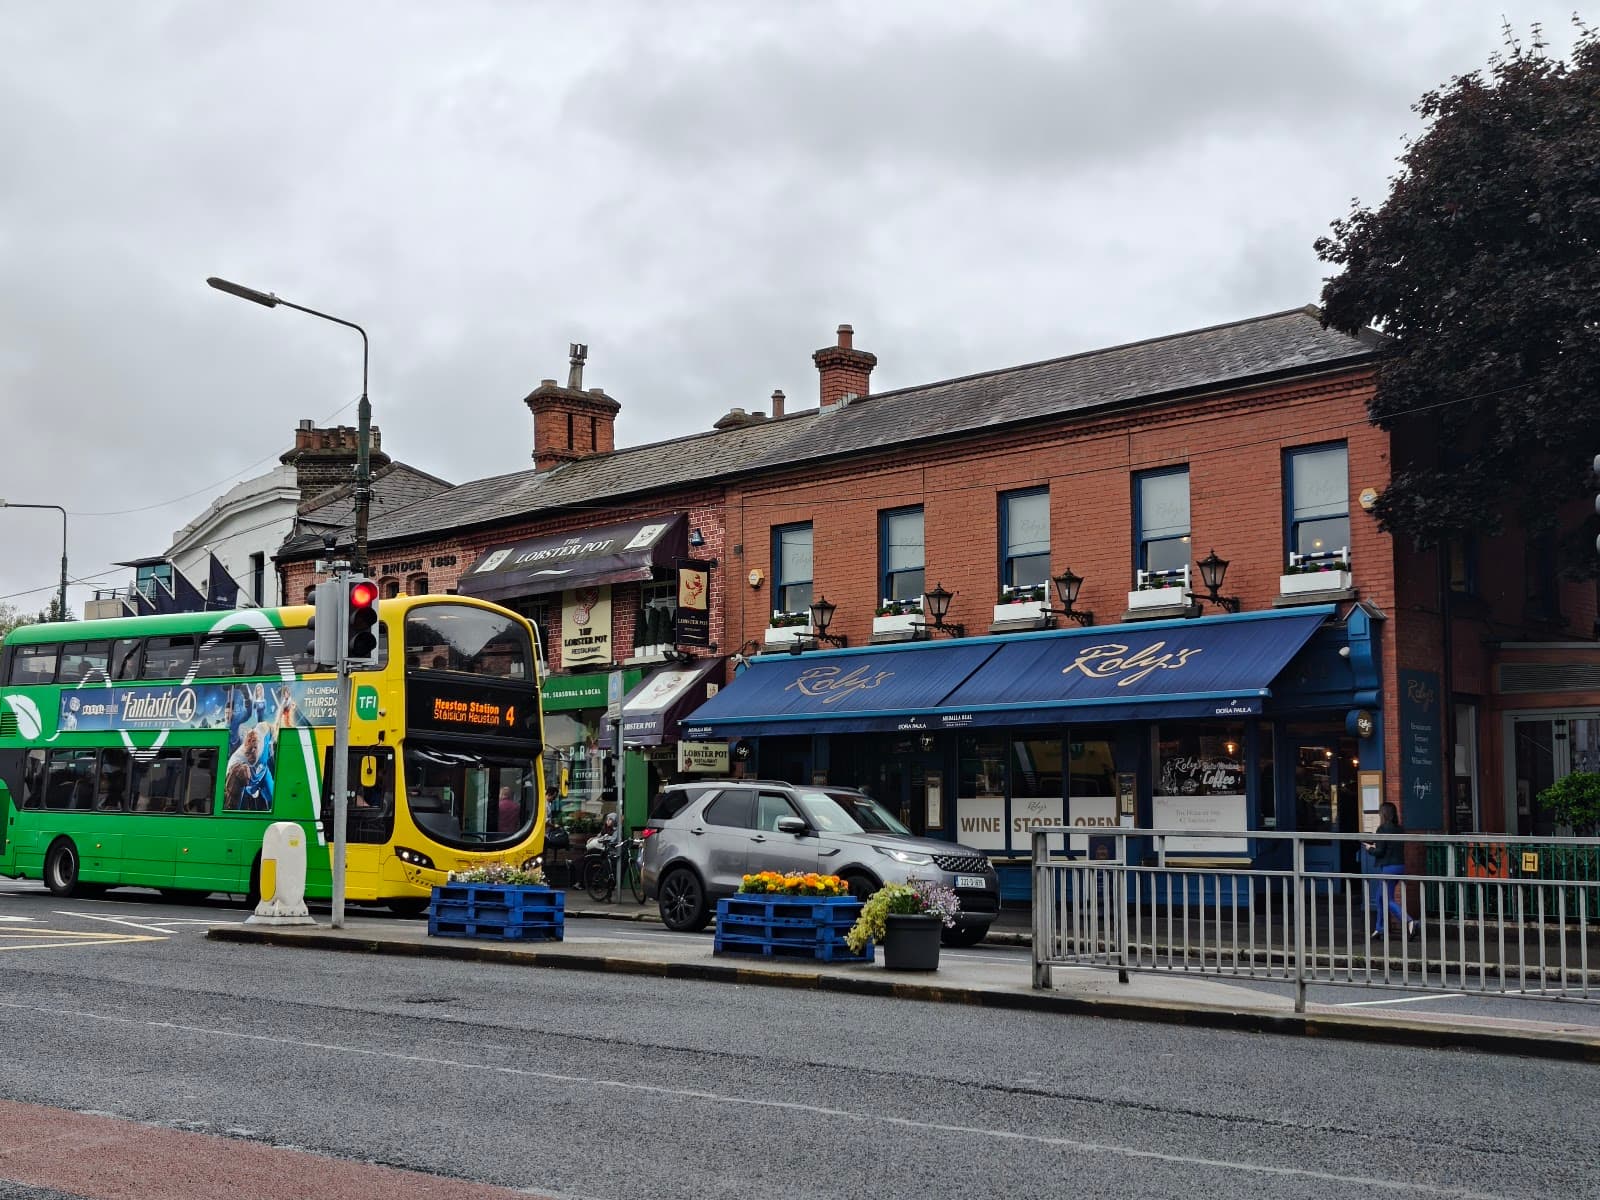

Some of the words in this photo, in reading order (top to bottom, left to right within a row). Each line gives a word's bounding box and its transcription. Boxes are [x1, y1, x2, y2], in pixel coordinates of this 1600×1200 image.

[514, 544, 581, 564] LOBSTER
[580, 540, 614, 554] POT
[564, 637, 594, 647] LOBSTER
[594, 635, 607, 644] POT
[1062, 641, 1202, 687] Roly's
[785, 664, 895, 704] Roly's
[552, 690, 578, 698] SEASONAL
[585, 688, 601, 696] LOCAL
[122, 691, 178, 721] Fantastic
[178, 690, 195, 719] 4
[304, 697, 338, 707] THURSDA
[359, 695, 377, 709] TFI
[434, 698, 468, 711] Heuston
[470, 702, 499, 714] Station
[310, 708, 326, 718] JULY
[468, 712, 500, 725] Heuston
[506, 705, 515, 727] 4
[624, 722, 643, 731] OBSTER
[644, 721, 657, 729] POT
[684, 749, 714, 758] LOBSTER
[714, 750, 727, 759] POT
[1202, 770, 1235, 788] Coffee
[960, 817, 1001, 832] WINE
